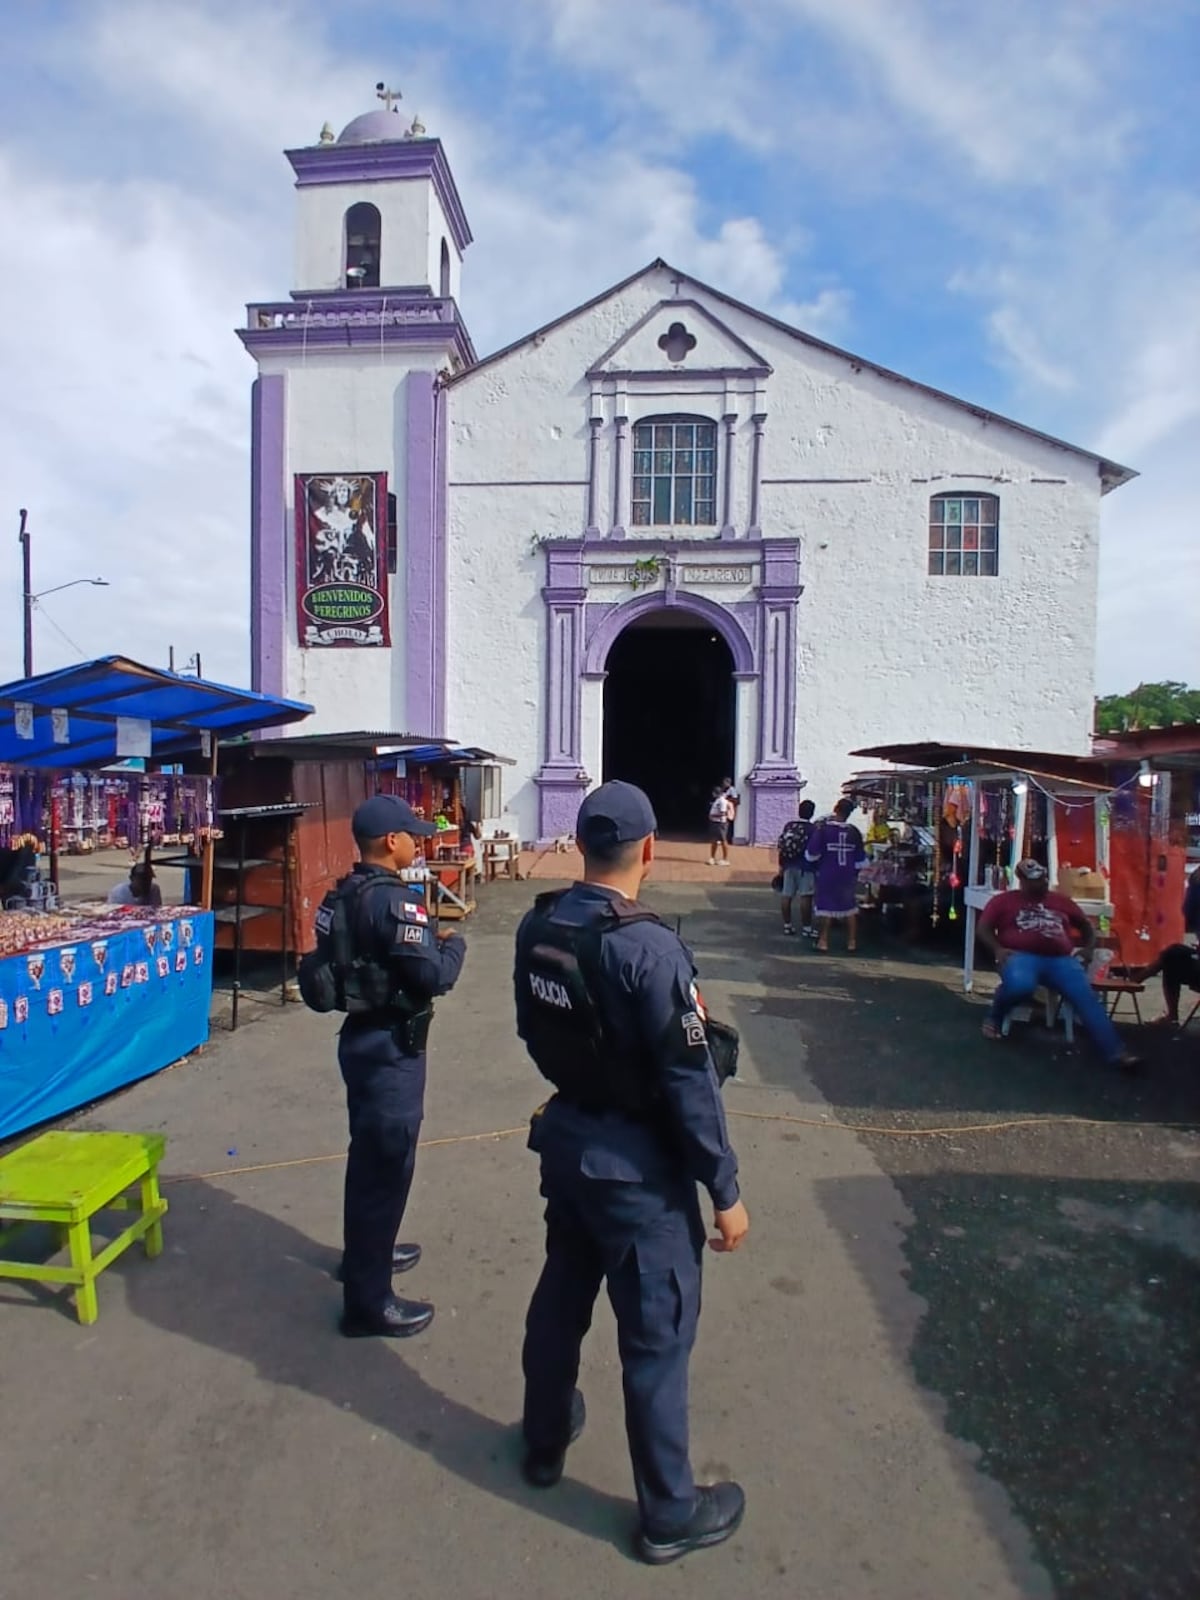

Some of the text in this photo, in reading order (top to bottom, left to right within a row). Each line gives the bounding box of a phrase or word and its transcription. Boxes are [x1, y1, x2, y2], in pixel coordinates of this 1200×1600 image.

[687, 569, 745, 581] NAZARENO
[312, 589, 373, 604] BIENVENIDOS
[314, 605, 371, 618] PEREGRINOS
[529, 972, 573, 1010] POLICIA
